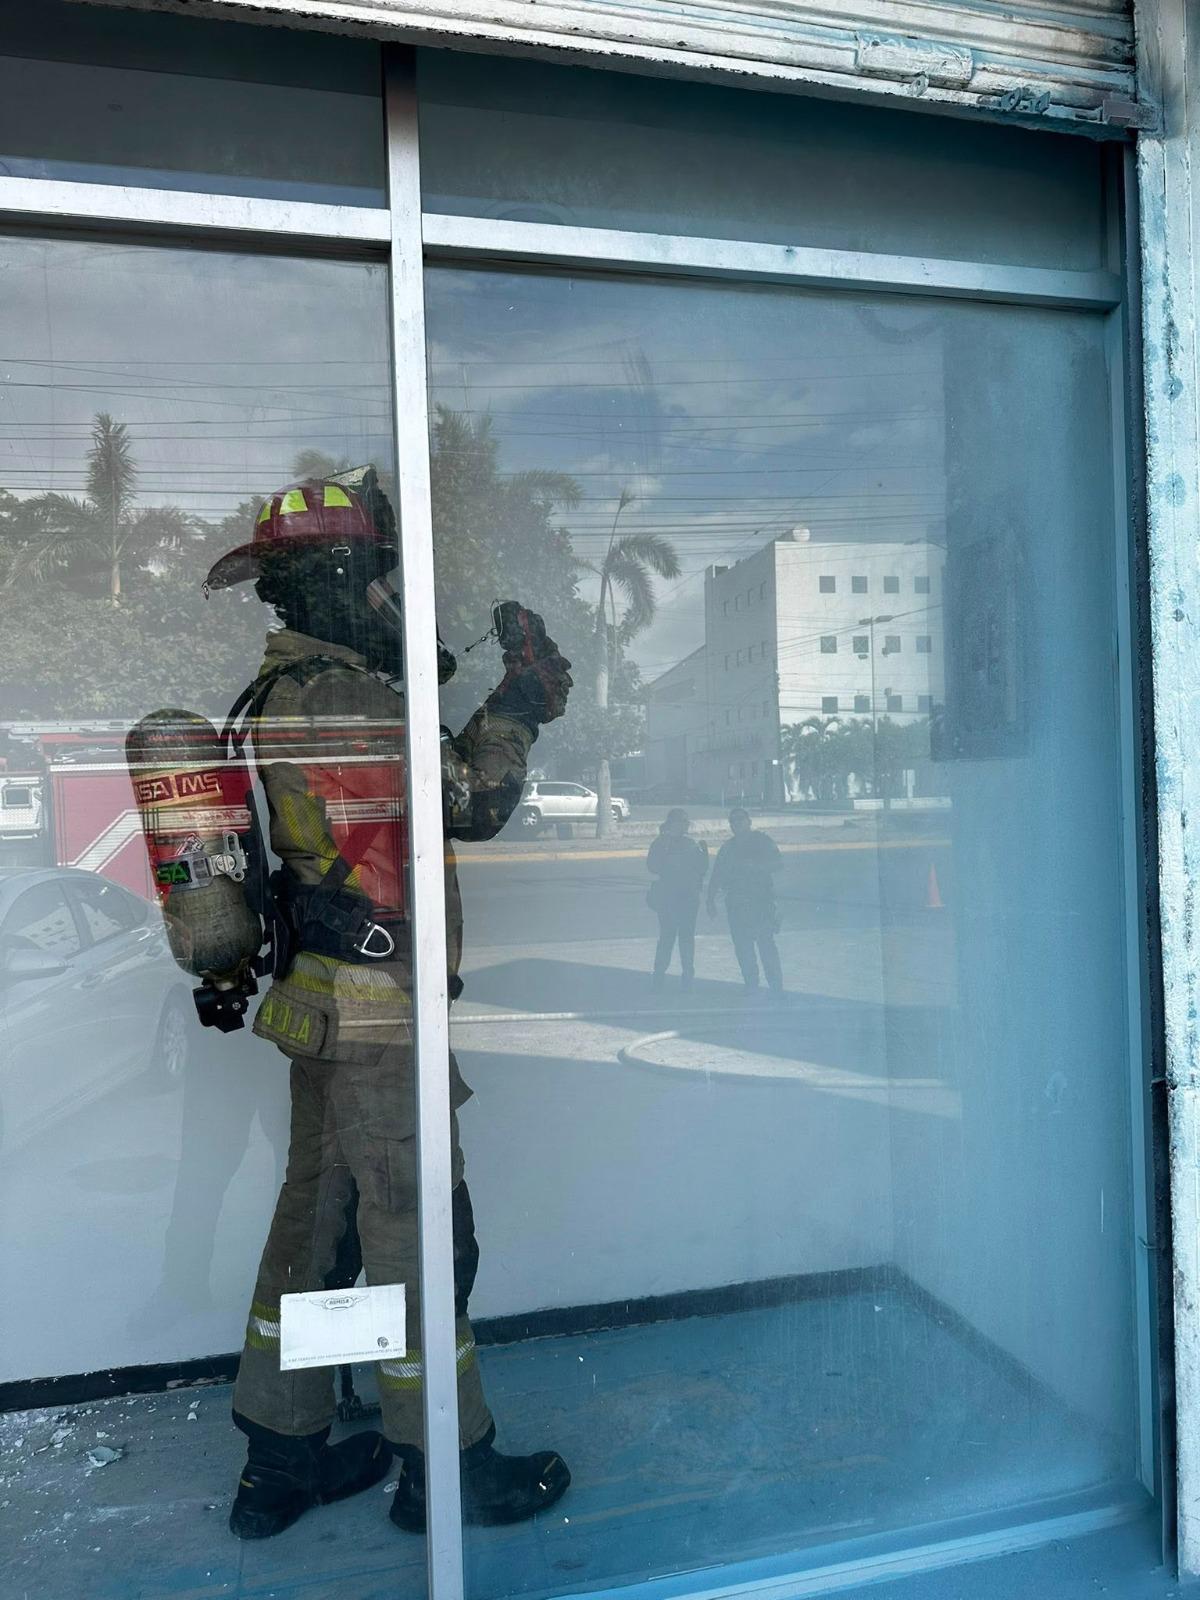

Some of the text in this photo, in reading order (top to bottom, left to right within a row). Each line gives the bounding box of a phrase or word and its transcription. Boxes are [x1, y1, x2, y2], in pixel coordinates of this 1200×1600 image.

[136, 772, 221, 801] SA MS
[156, 862, 189, 884] SA
